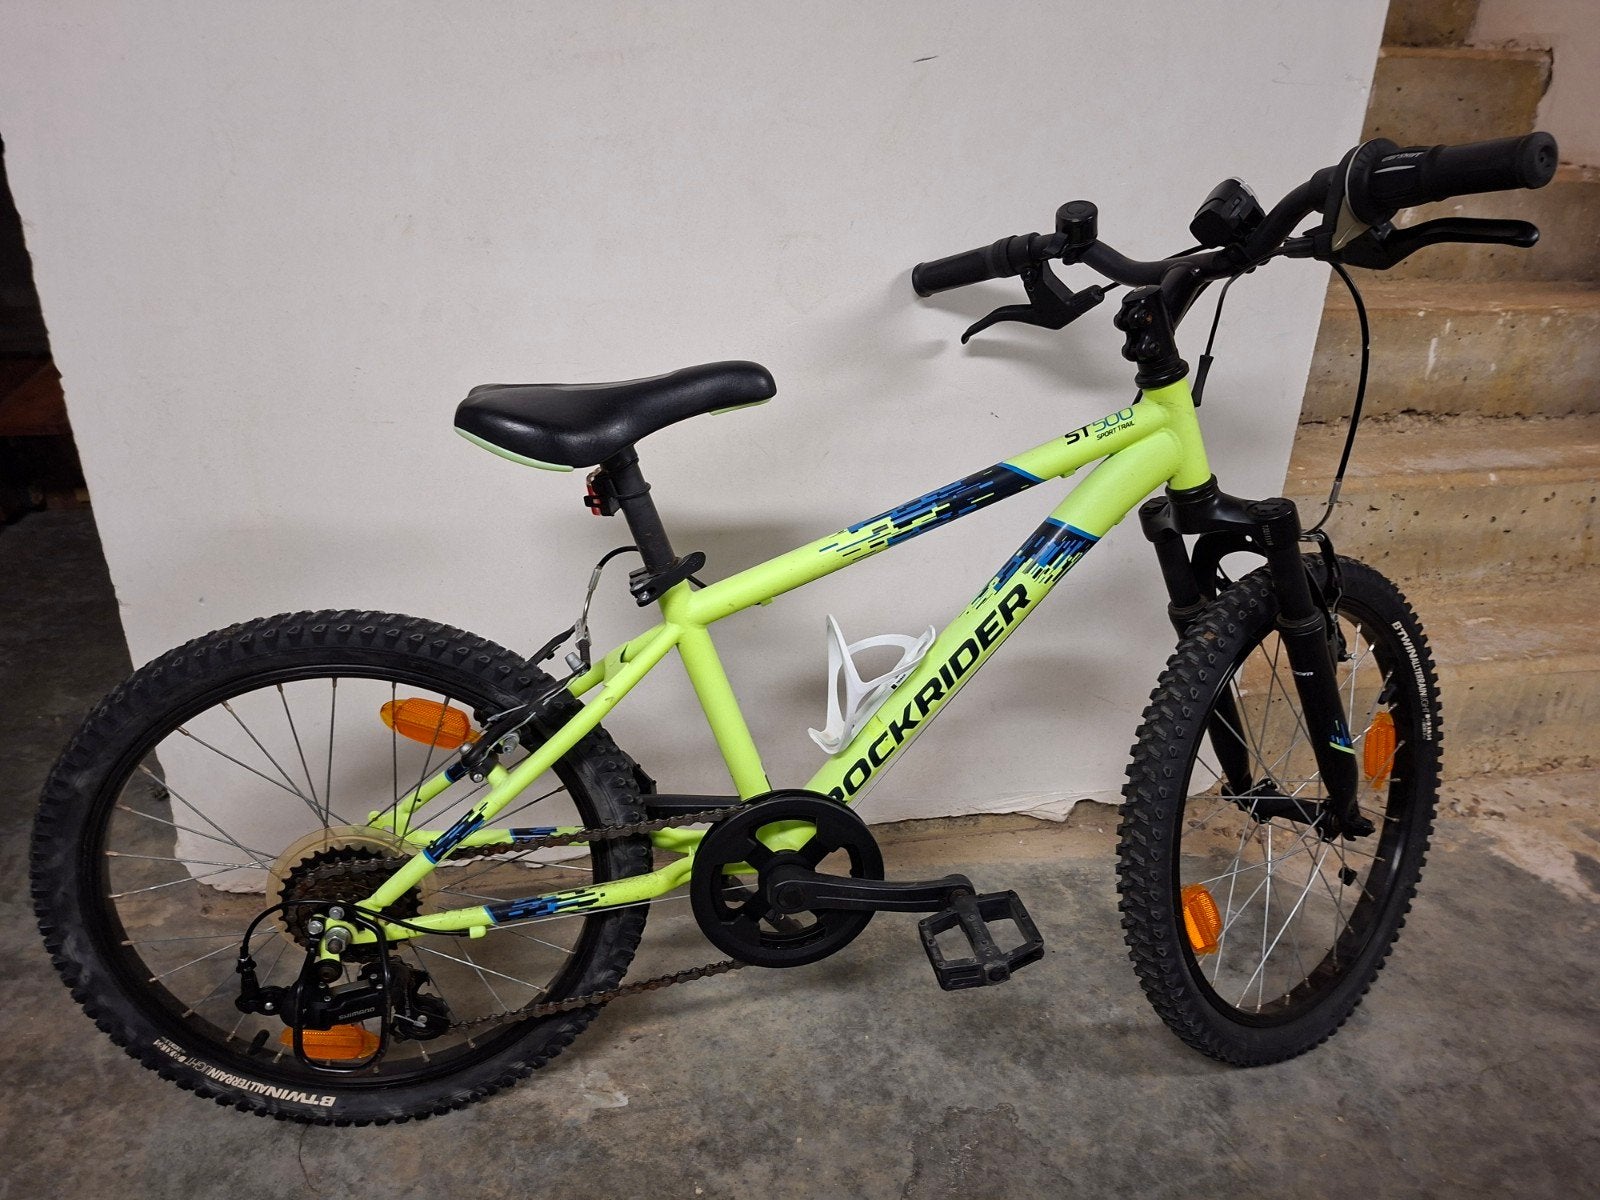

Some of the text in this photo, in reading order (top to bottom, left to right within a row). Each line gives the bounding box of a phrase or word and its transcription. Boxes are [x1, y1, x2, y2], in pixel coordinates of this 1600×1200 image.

[1064, 407, 1134, 445] ST500
[1096, 420, 1135, 441] SPORT TRAIL
